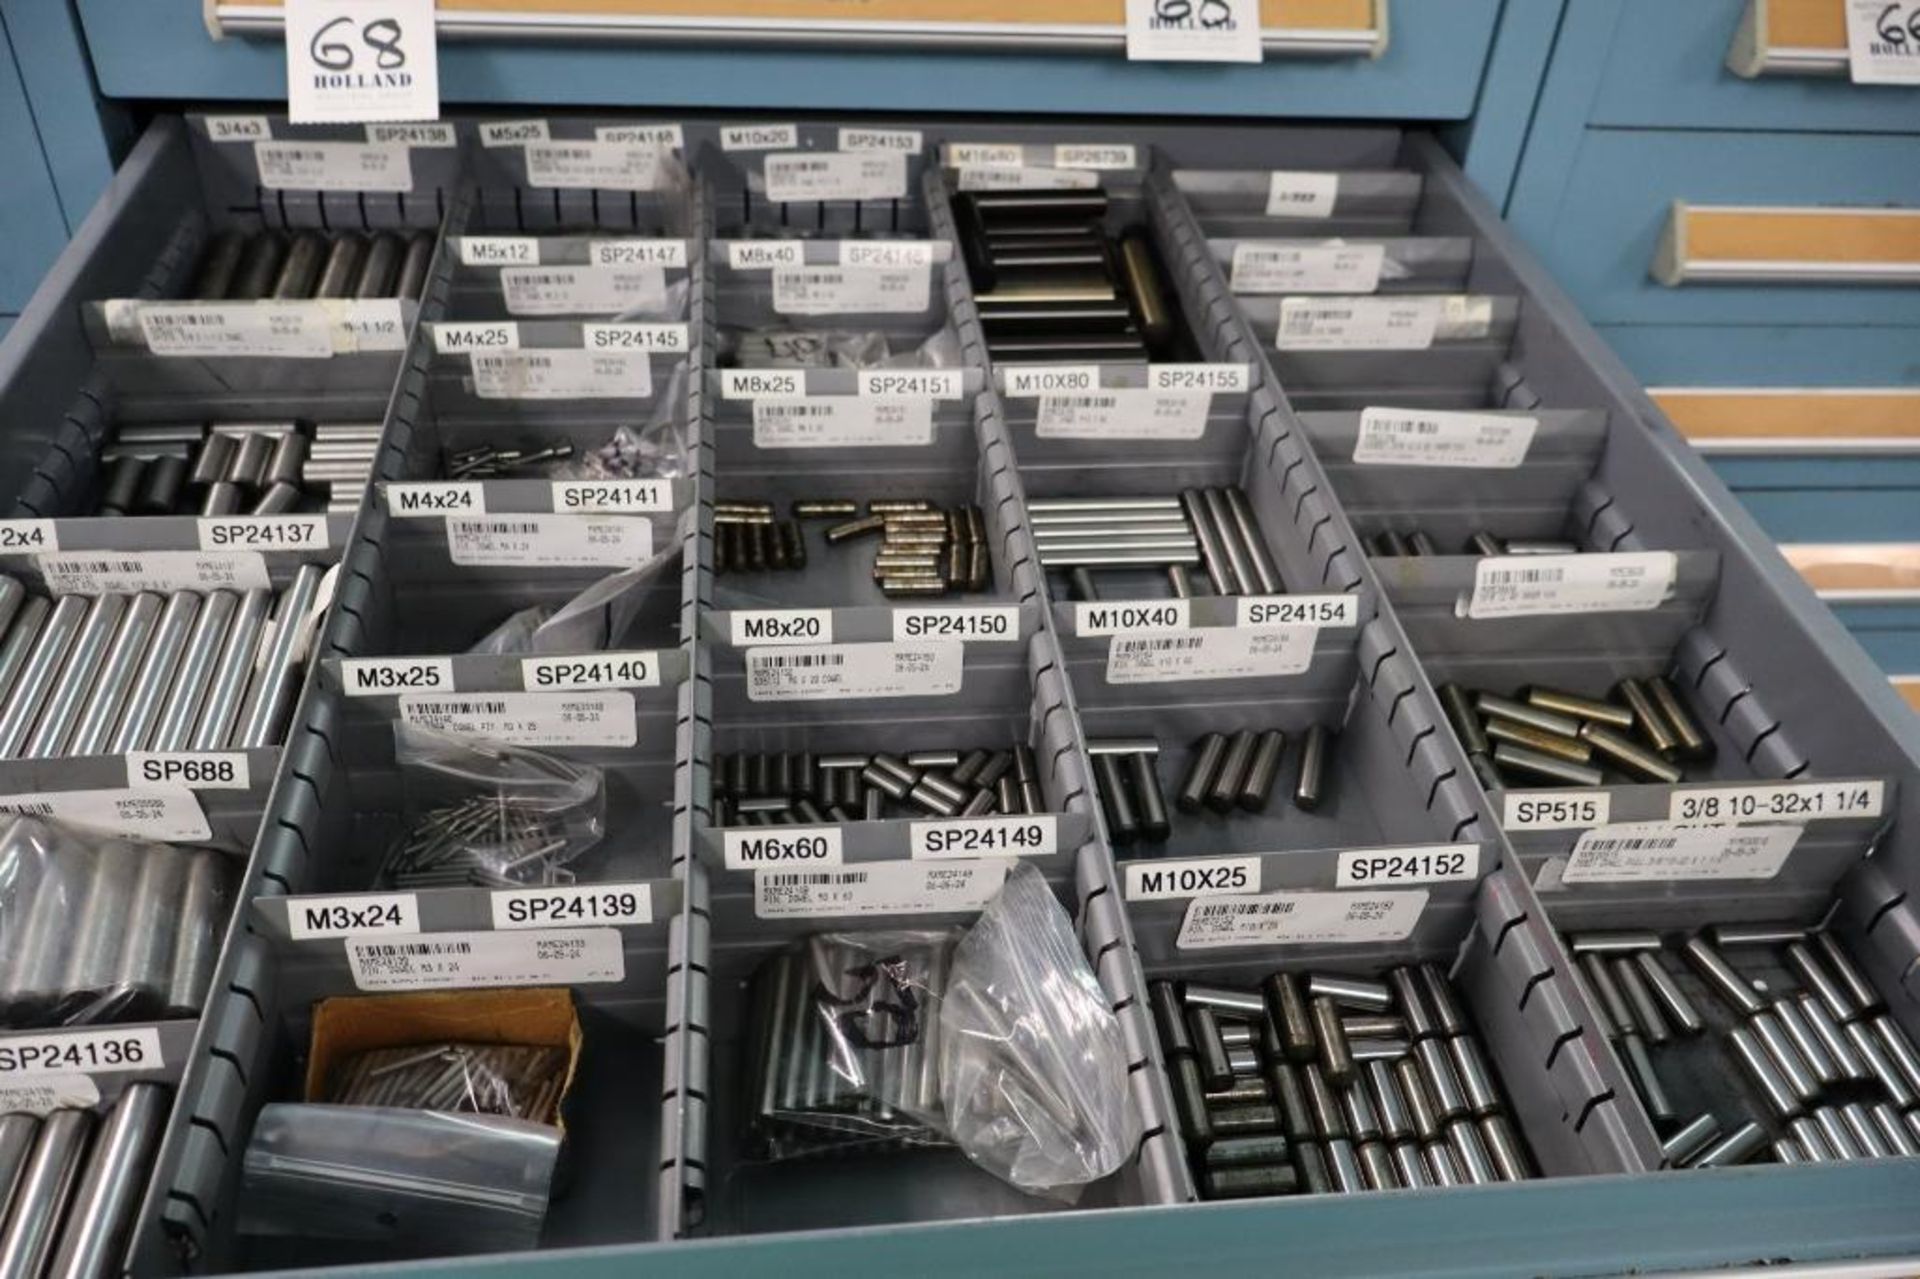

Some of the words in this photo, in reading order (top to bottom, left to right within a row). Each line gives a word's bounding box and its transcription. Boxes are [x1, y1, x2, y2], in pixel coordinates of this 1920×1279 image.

[310, 17, 405, 70] 68
[314, 74, 412, 88] HOLLAND
[216, 122, 262, 137] 3/4x3
[375, 126, 448, 142] SP24138
[729, 130, 790, 145] M10x20
[847, 134, 914, 149] SP24153
[472, 244, 529, 259] M5x12
[600, 247, 676, 263] SP24147
[740, 247, 795, 263] M8x40
[446, 329, 509, 347] M4x25
[594, 329, 679, 347] SP24145
[734, 376, 795, 394] M8x25
[869, 377, 951, 394] SP24151
[1016, 373, 1089, 390] M10X80
[1158, 371, 1239, 388] SP24155
[400, 490, 473, 510] M4x24
[564, 487, 659, 507] SP24141
[211, 523, 316, 545] SP24137
[1089, 607, 1178, 629] M10X40
[1248, 602, 1346, 623] SP24154
[744, 617, 820, 638] M8x20
[905, 614, 1008, 636] SP24150
[356, 666, 441, 688] M3x25
[536, 660, 647, 685] SP24140
[143, 759, 235, 782] SP688
[1516, 801, 1597, 823] SP515
[1682, 796, 1720, 819] 3/8
[1730, 790, 1826, 817] 10-32x1
[1837, 789, 1871, 809] 1/4
[740, 836, 828, 861] M6x60
[925, 825, 1043, 852] SP24149
[1350, 853, 1466, 880] SP24152
[1141, 866, 1248, 893] M10X25
[306, 903, 404, 930] M3x24
[508, 892, 637, 923] SP24139
[0, 1038, 144, 1072] SP24136
